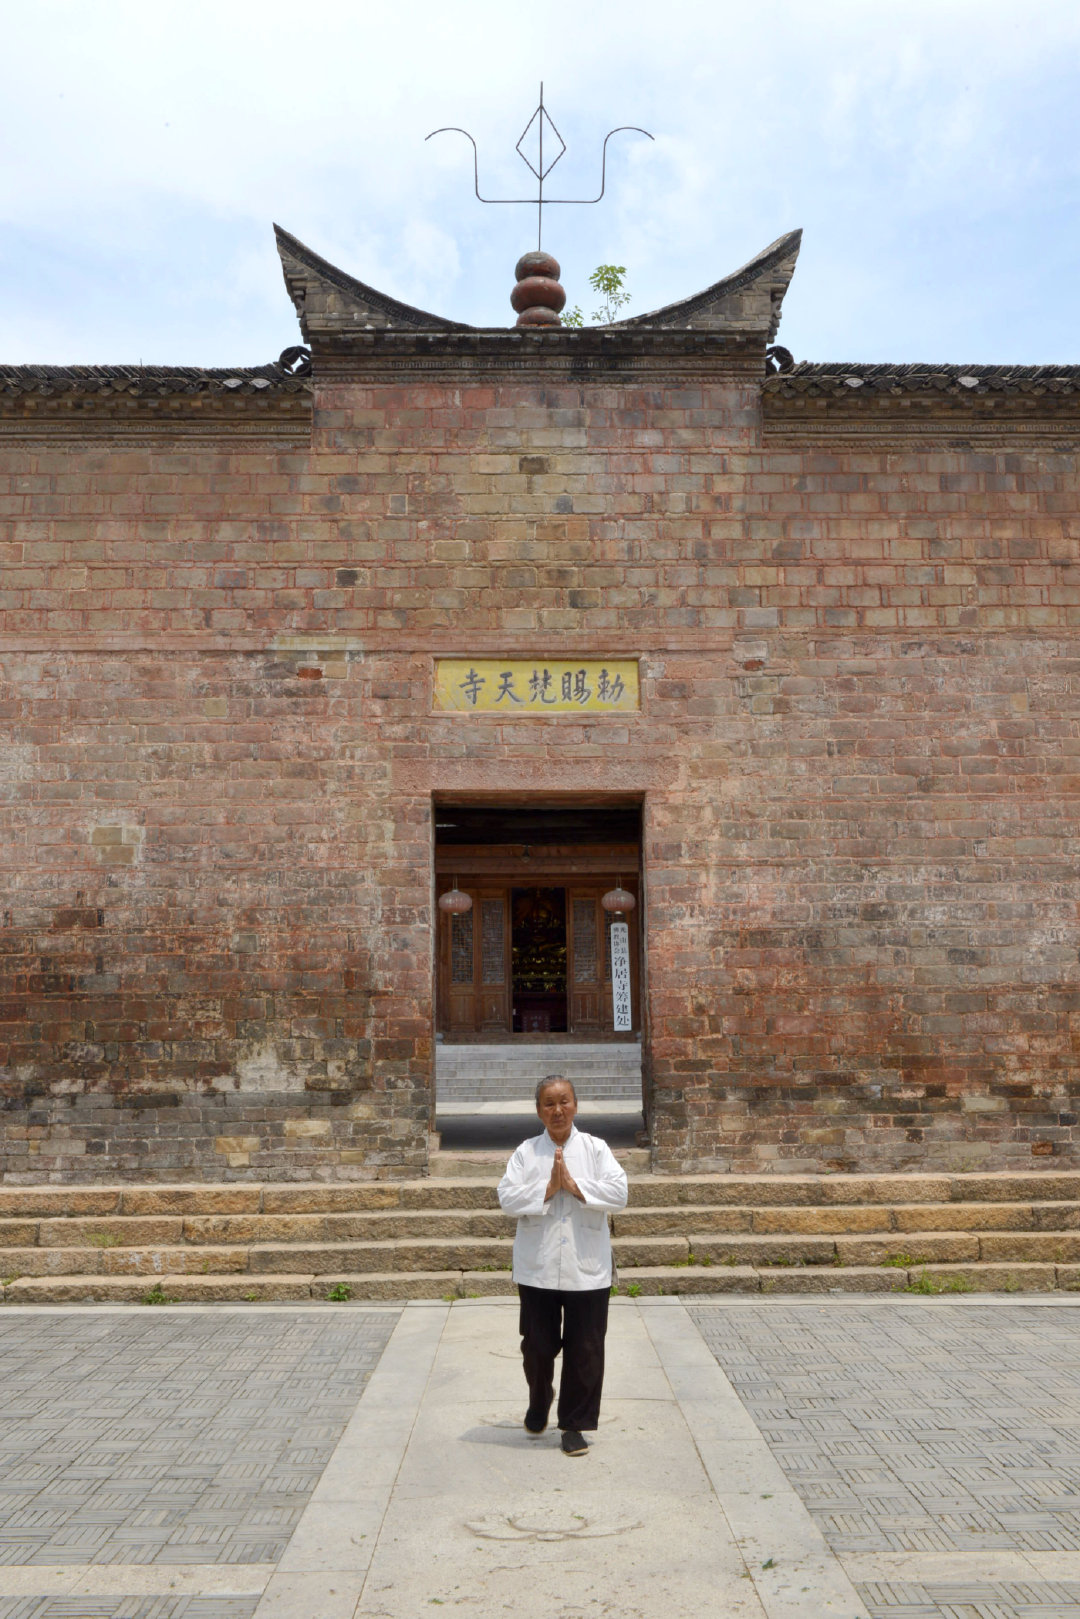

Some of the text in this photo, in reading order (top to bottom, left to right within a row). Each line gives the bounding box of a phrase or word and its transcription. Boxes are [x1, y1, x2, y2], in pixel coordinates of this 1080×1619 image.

[614, 956, 629, 1026] 净居寺筹建处
